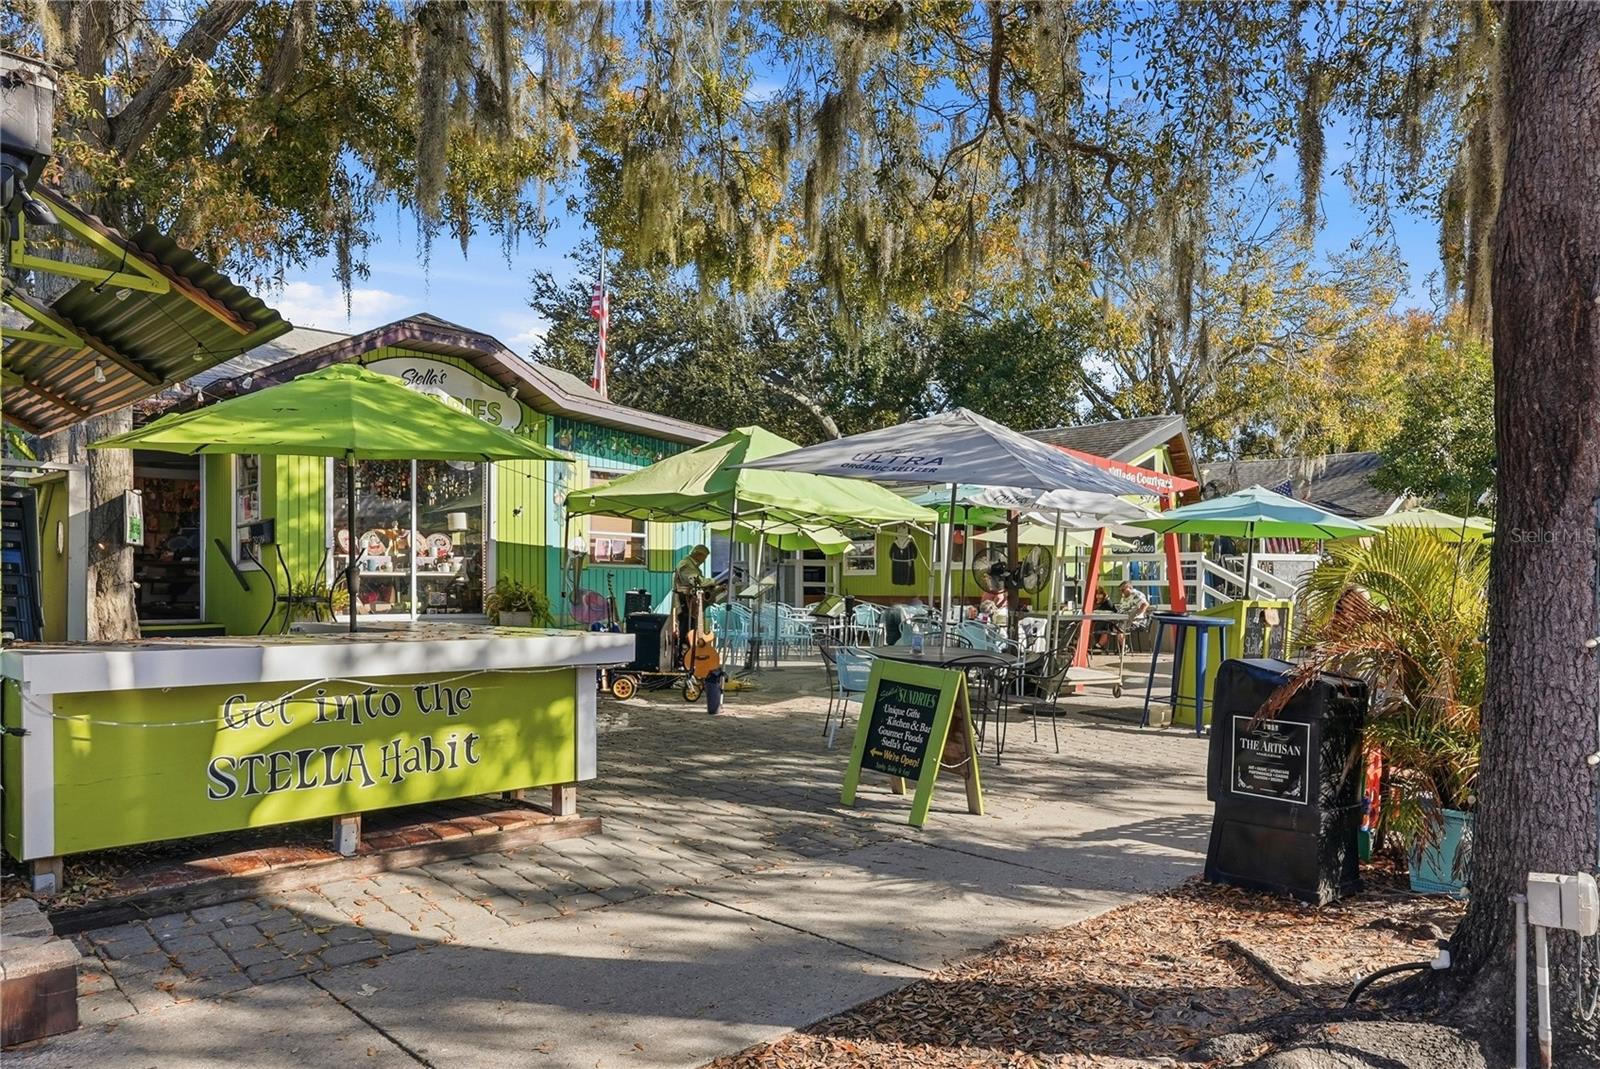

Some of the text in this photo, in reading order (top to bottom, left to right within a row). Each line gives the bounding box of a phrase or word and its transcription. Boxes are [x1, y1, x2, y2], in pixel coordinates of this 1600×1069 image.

[401, 367, 448, 386] Stella's
[840, 462, 889, 472] ORGANIC
[851, 453, 944, 466] ULTRA
[223, 681, 473, 731] Get into the
[883, 704, 920, 719] Unique Gifts
[886, 716, 931, 733] Kitchen & Bar
[878, 726, 923, 743] Gourmet Foods
[902, 742, 917, 752] Gear
[1240, 737, 1260, 751] THE
[1260, 741, 1301, 756] ARTISAN
[883, 750, 900, 762] We're
[207, 731, 481, 801] STELLA Habit
